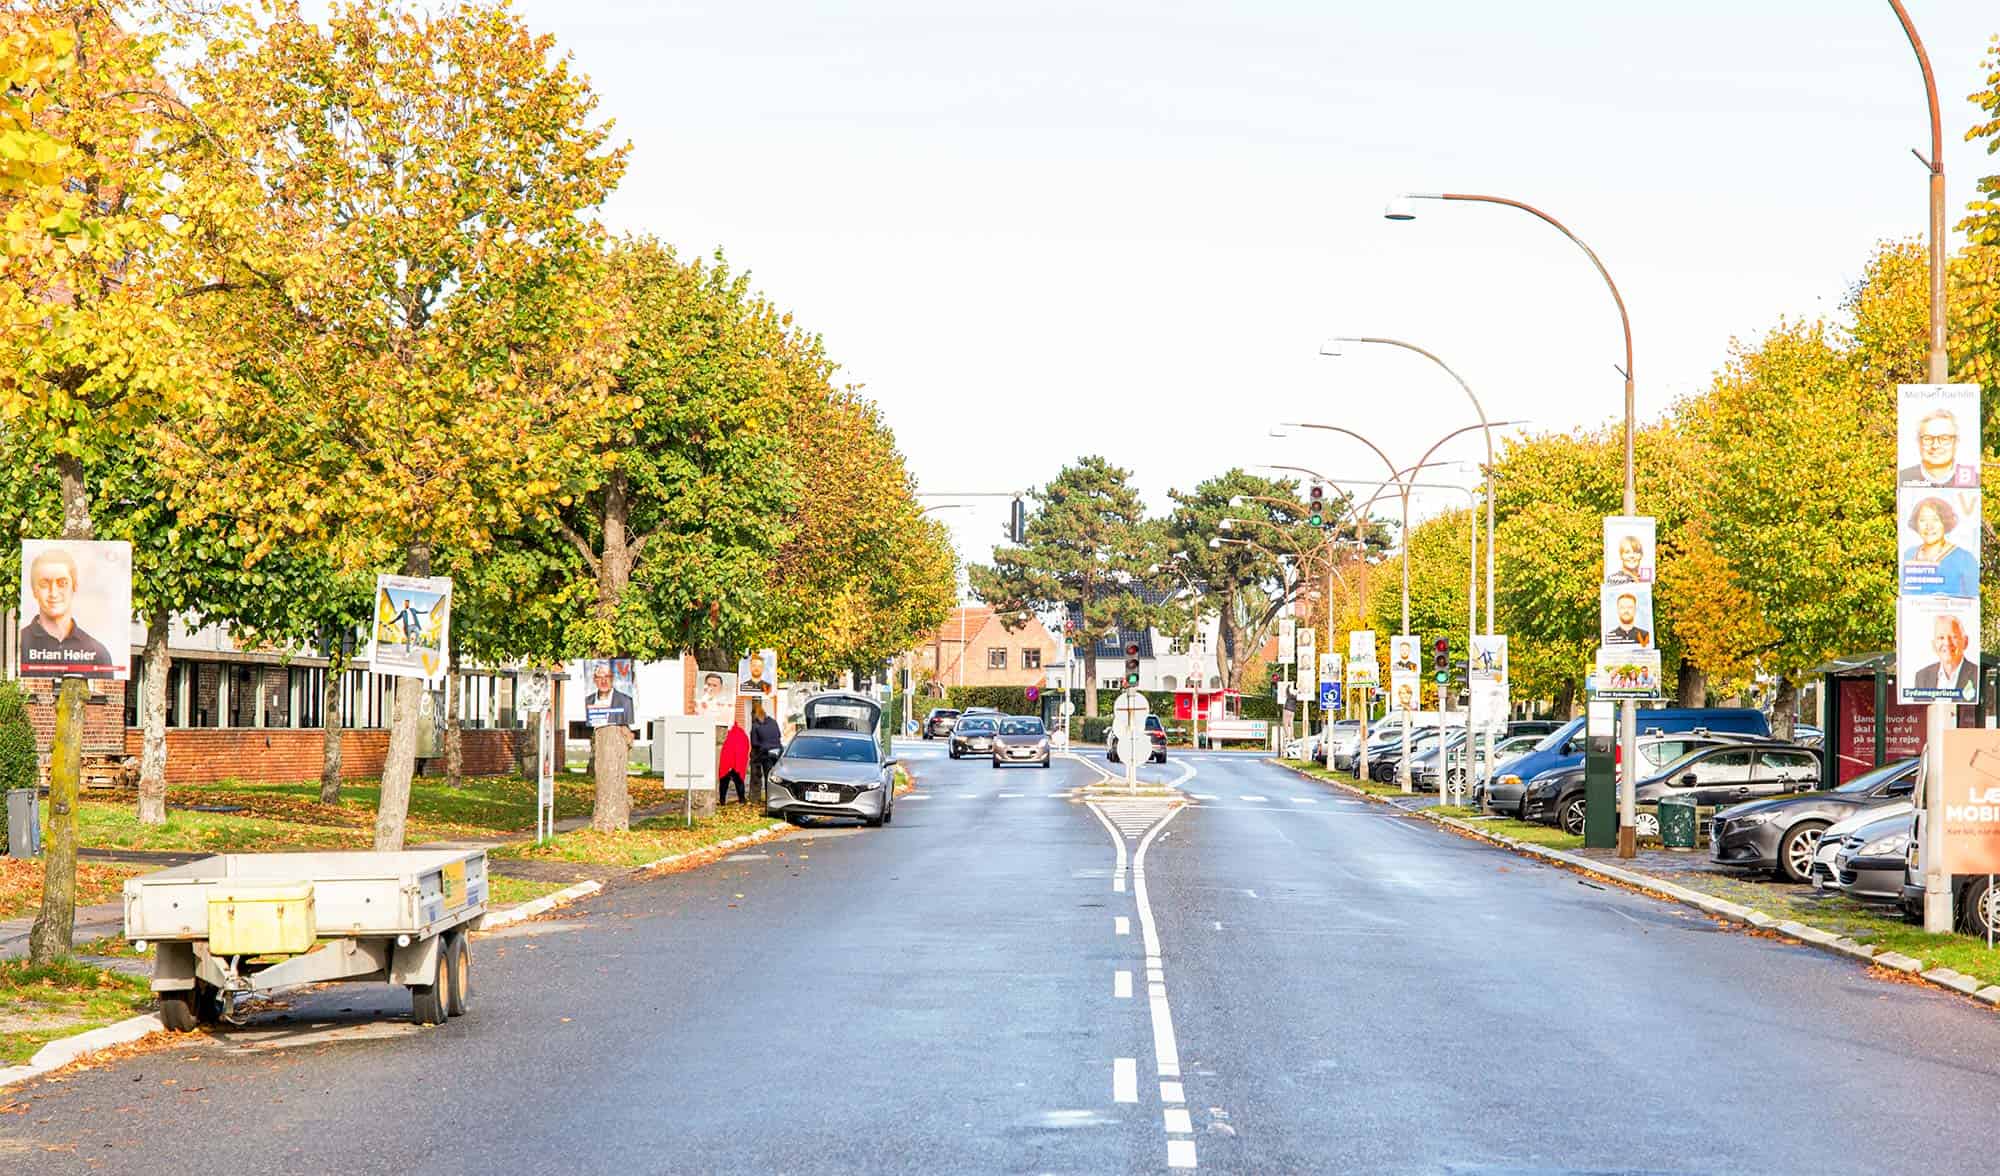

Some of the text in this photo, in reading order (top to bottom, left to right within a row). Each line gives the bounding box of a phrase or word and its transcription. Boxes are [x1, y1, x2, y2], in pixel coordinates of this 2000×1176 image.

[1958, 467, 1972, 482] B
[1958, 493, 1977, 515] V
[28, 648, 97, 661] Brian Høier
[421, 651, 441, 677] V
[1906, 714, 1918, 723] du
[1853, 725, 1871, 733] skal
[1904, 725, 1913, 733] vi
[1853, 735, 1865, 745] på
[1899, 735, 1920, 745] rejse
